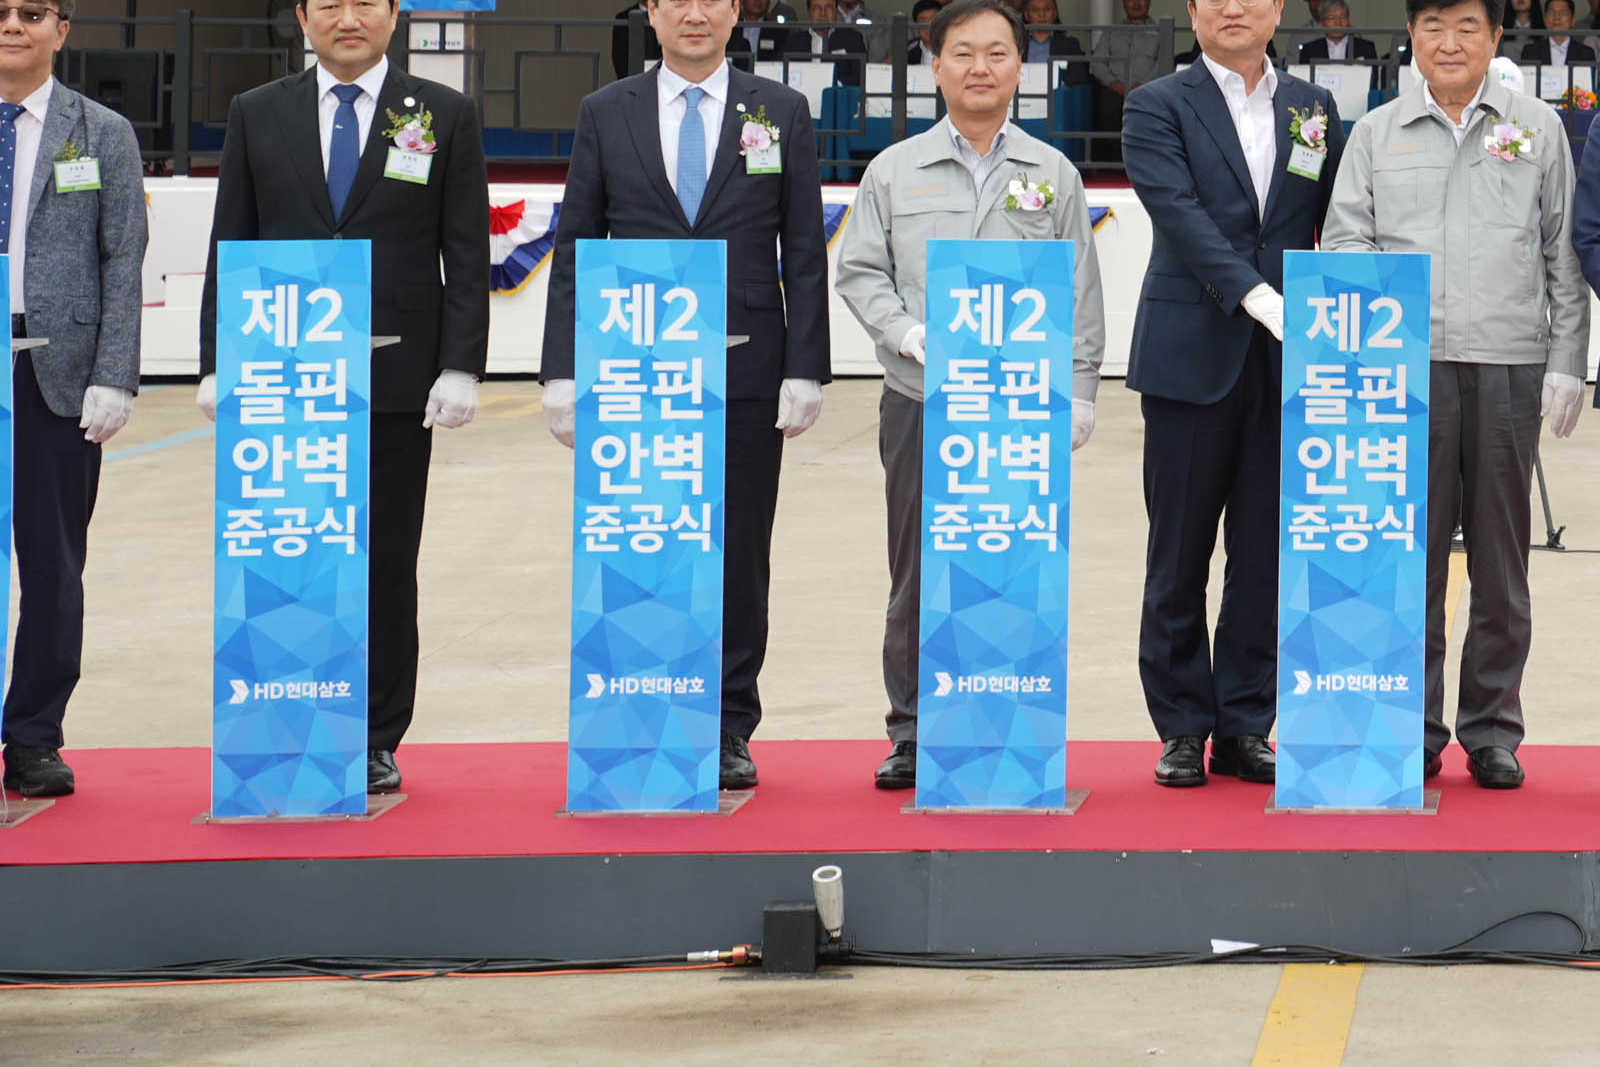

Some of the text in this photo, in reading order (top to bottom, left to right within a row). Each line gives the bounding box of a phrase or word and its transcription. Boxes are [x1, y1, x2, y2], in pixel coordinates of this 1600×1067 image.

[242, 285, 342, 347] 제2
[600, 284, 698, 345] 제2
[949, 285, 1046, 346] 제2
[1306, 294, 1402, 352] 제2
[234, 358, 347, 424] 돌핀
[592, 358, 703, 421] 돌핀
[941, 358, 1050, 421] 돌핀
[1299, 364, 1407, 424] 돌핀
[233, 434, 346, 497] 안벽
[592, 432, 702, 495] 안벽
[940, 432, 1049, 495] 안벽
[1298, 435, 1406, 496] 안벽
[223, 506, 354, 556] 준공식
[582, 503, 710, 553] 준공식
[930, 504, 1057, 552] 준공식
[1289, 504, 1414, 552] 준공식
[254, 680, 351, 700] HD현대삼호
[610, 675, 704, 695] HD현대삼호
[958, 674, 1052, 694] HD현대삼호
[1317, 674, 1409, 693] HD현대삼호
